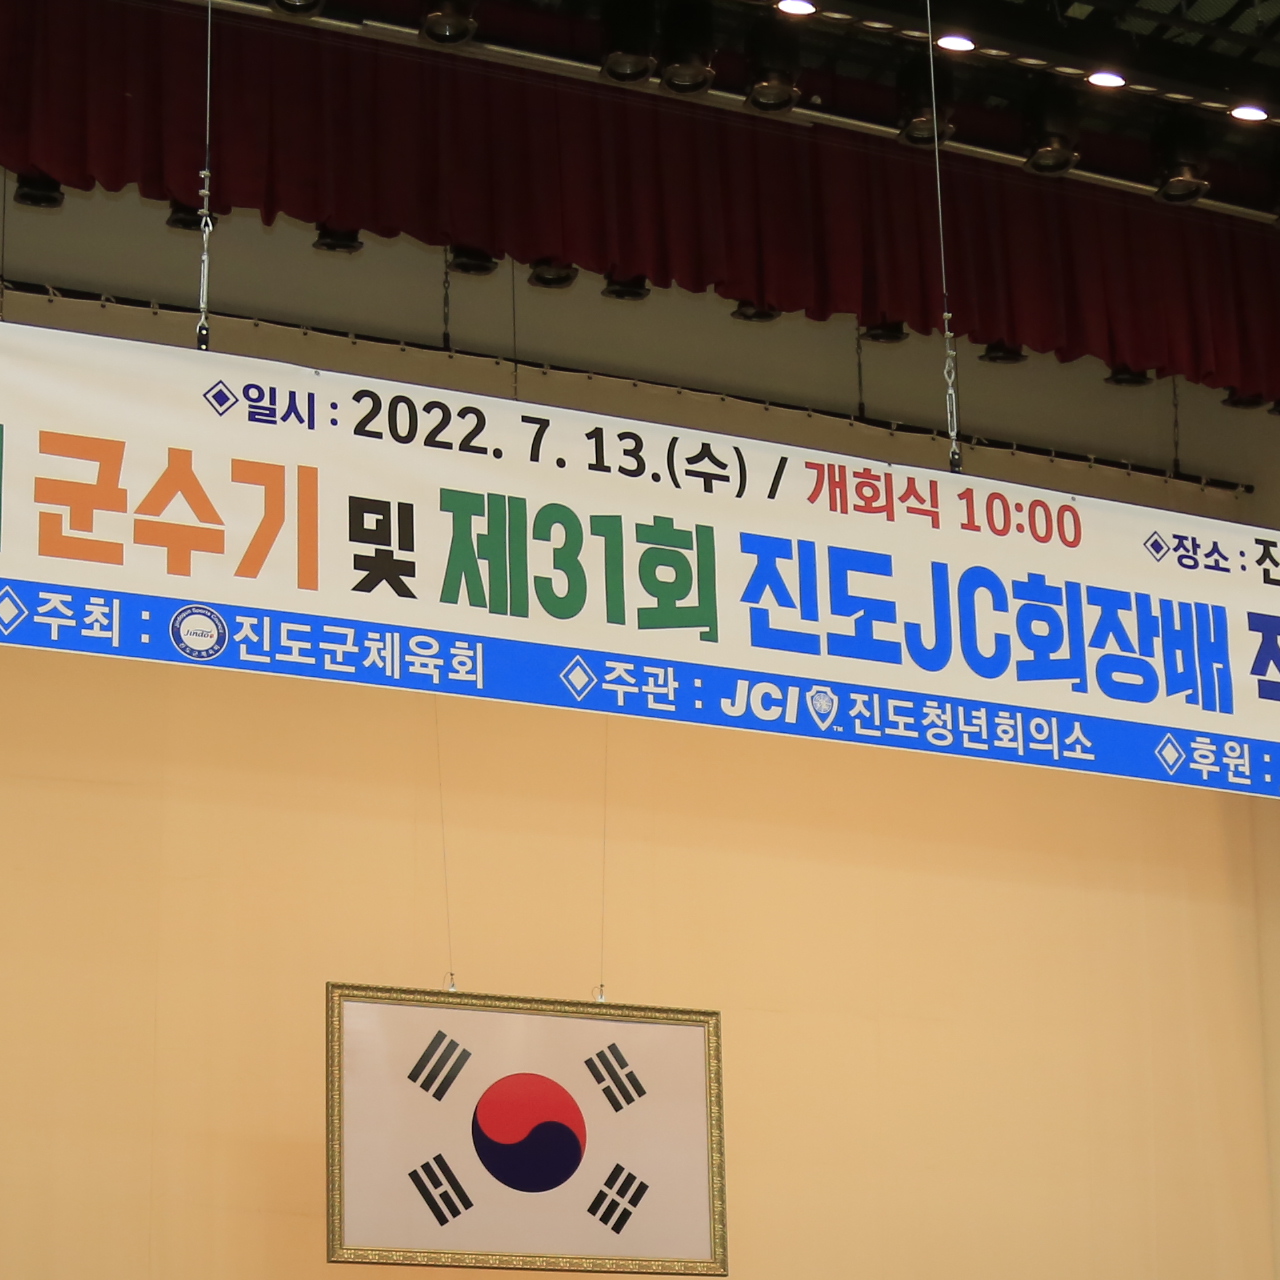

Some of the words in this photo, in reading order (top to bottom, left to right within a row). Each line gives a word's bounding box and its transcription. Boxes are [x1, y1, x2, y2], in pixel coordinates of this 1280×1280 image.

[351, 389, 503, 460] 2022.
[806, 460, 940, 529] 개회식
[957, 487, 1083, 549] 10:00
[34, 430, 318, 591] 군수기
[349, 496, 418, 599] 및
[439, 487, 719, 643] 제31회
[739, 532, 1234, 714] 진도JC회장배
[34, 592, 120, 648] 주최
[234, 614, 484, 689] 진도군체육회
[601, 660, 679, 712] 주관
[721, 679, 800, 724] JCI
[849, 693, 1095, 762] 진도청년회의소
[1190, 738, 1252, 784] 후원
